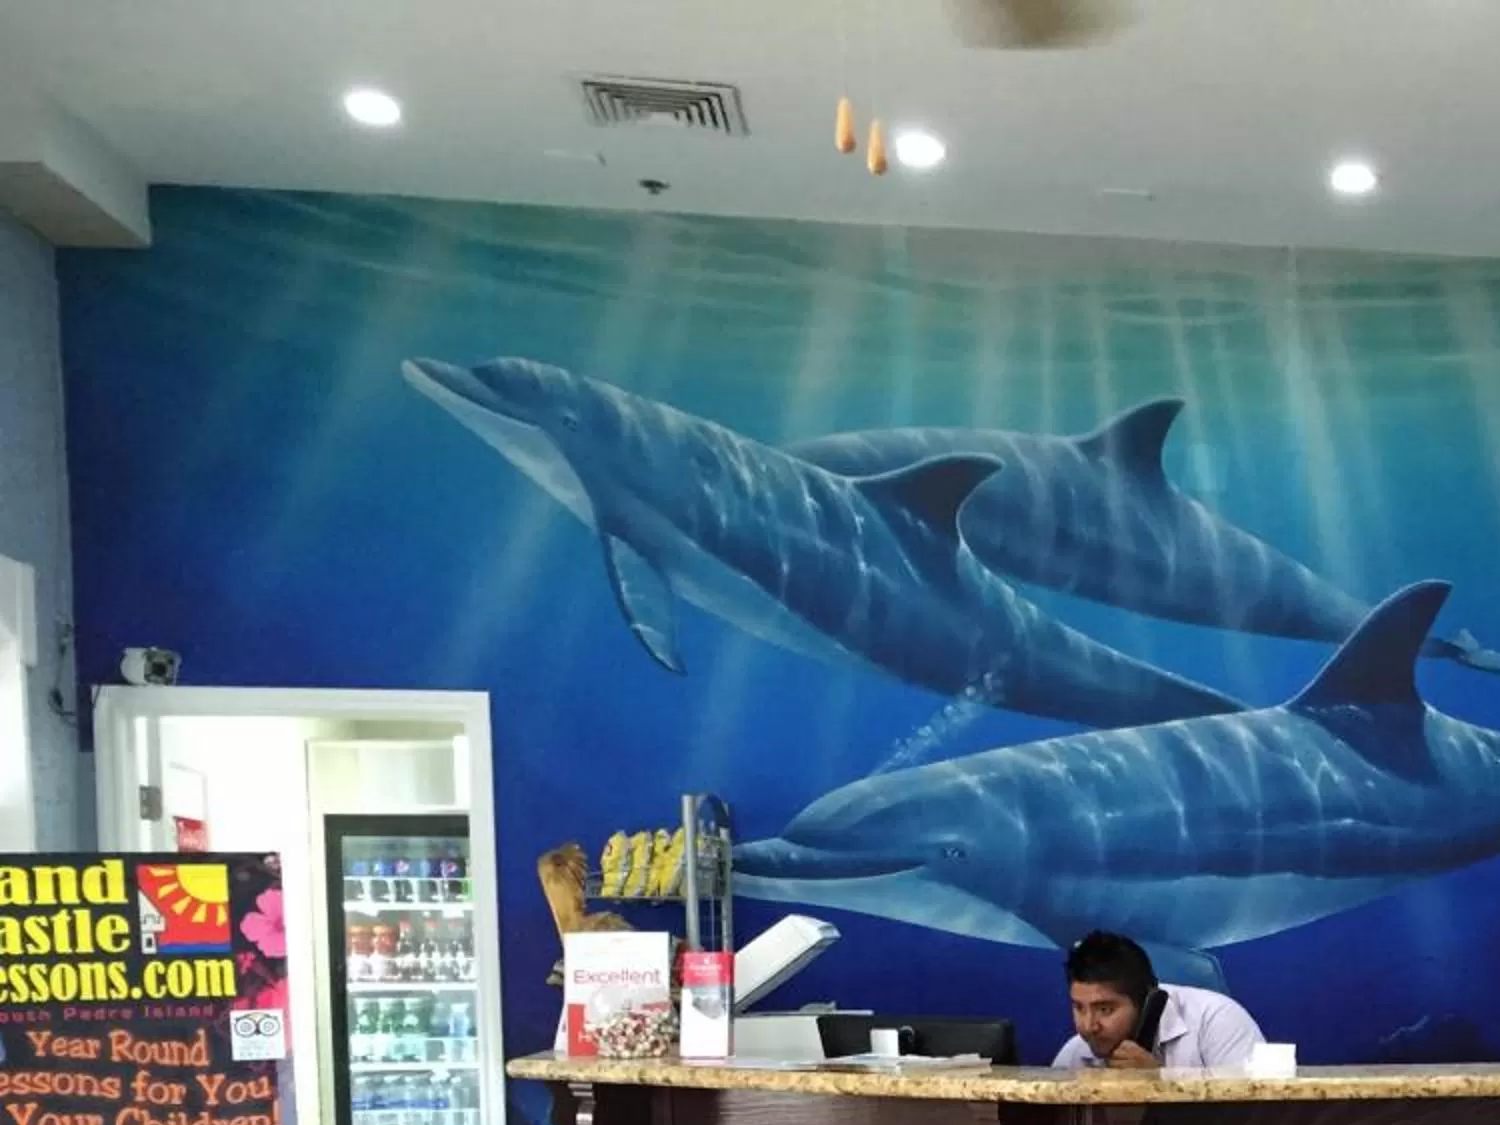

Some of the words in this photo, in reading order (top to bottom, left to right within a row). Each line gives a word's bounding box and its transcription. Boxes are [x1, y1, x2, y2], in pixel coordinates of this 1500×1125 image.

[0, 859, 129, 904] and
[0, 909, 131, 954] astle
[573, 967, 662, 985] Excellent
[25, 1030, 101, 1060] Year
[108, 1027, 210, 1067] Round
[131, 1069, 187, 1105] for
[195, 1074, 273, 1105] You
